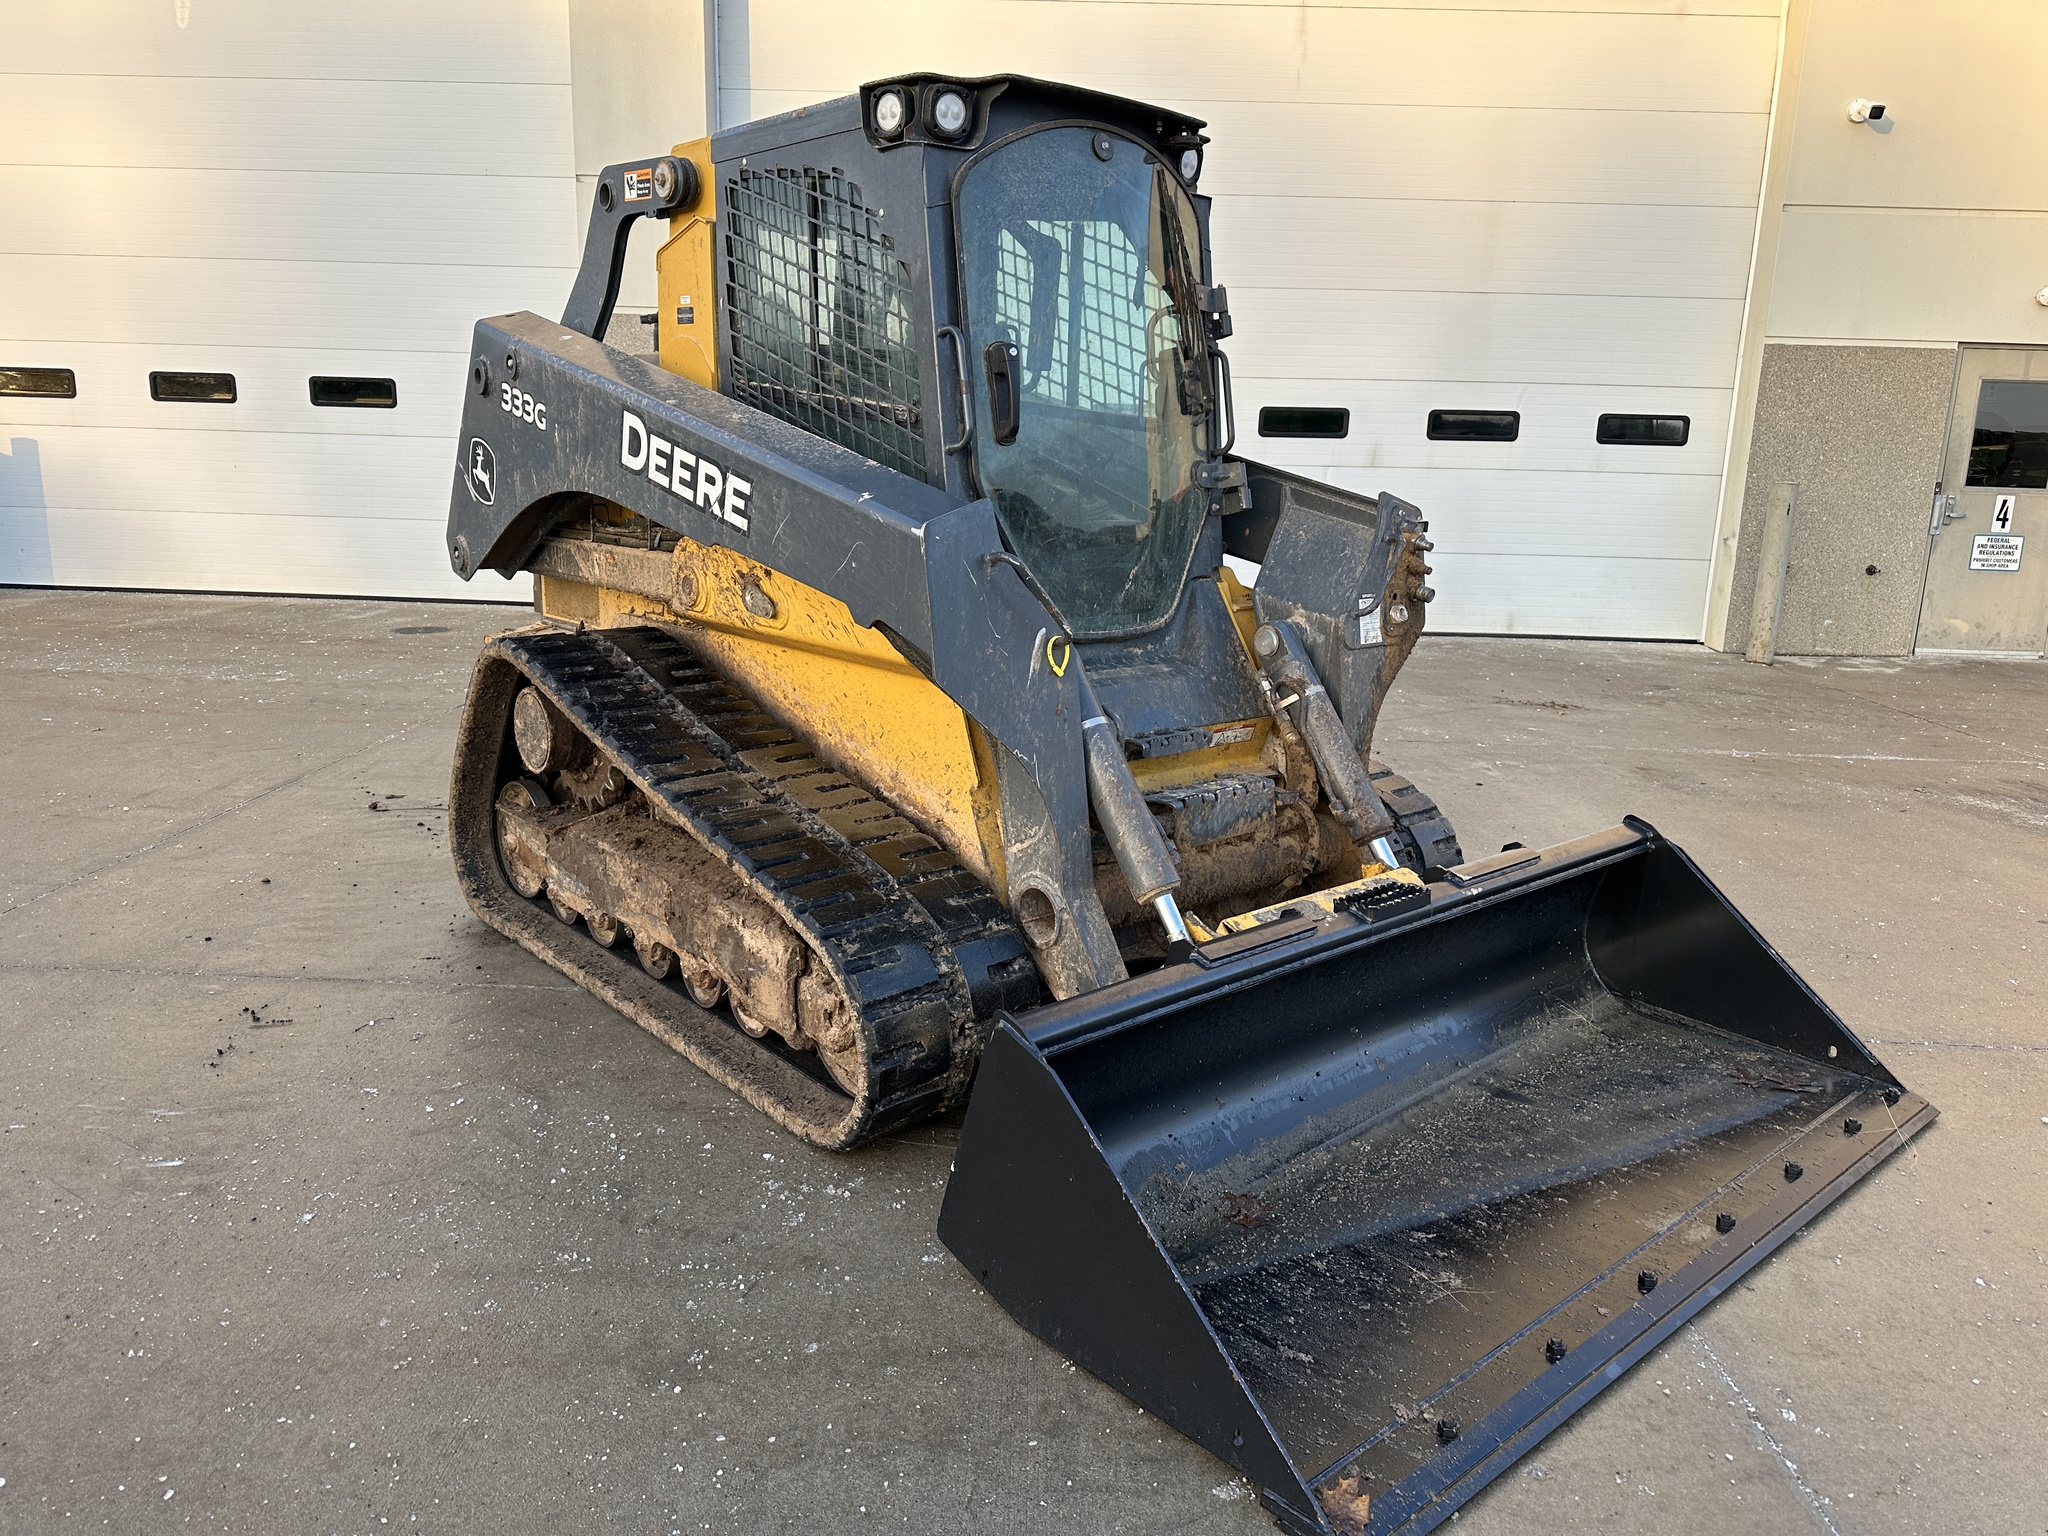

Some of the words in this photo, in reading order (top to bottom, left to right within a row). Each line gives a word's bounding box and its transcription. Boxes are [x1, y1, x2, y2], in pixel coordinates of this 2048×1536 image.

[500, 382, 547, 431] 333G
[620, 409, 752, 532] DEERE
[1995, 499, 2009, 529] 4
